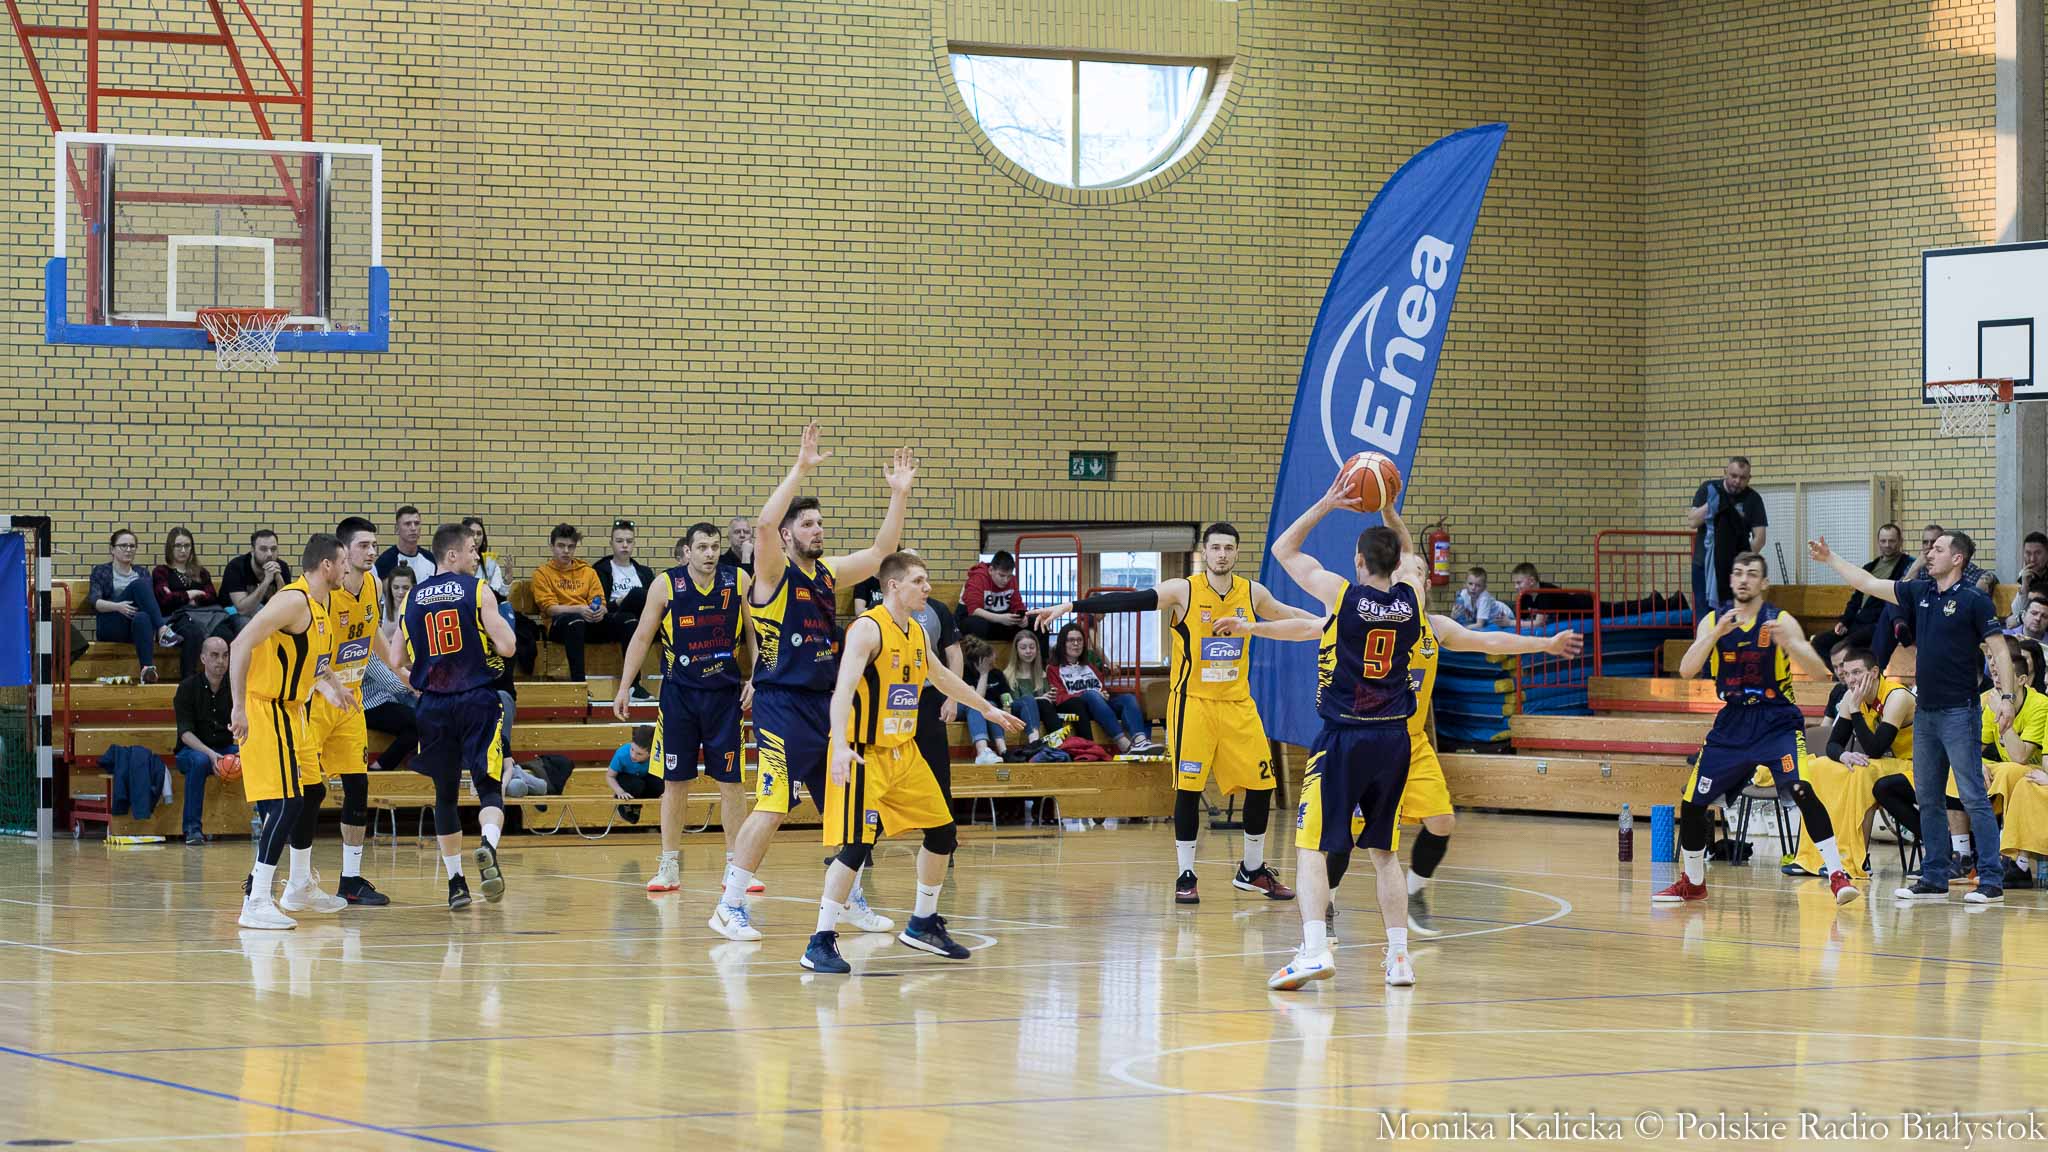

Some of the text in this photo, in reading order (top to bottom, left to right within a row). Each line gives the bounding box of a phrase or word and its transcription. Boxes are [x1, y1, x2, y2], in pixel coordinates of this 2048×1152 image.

[1350, 234, 1455, 456] Enea
[348, 622, 364, 640] 88
[425, 609, 463, 656] 18
[343, 646, 368, 660] Enea
[1210, 646, 1241, 657] Enea
[1363, 628, 1397, 679] 9
[902, 664, 910, 683] 9
[724, 751, 735, 772] 7
